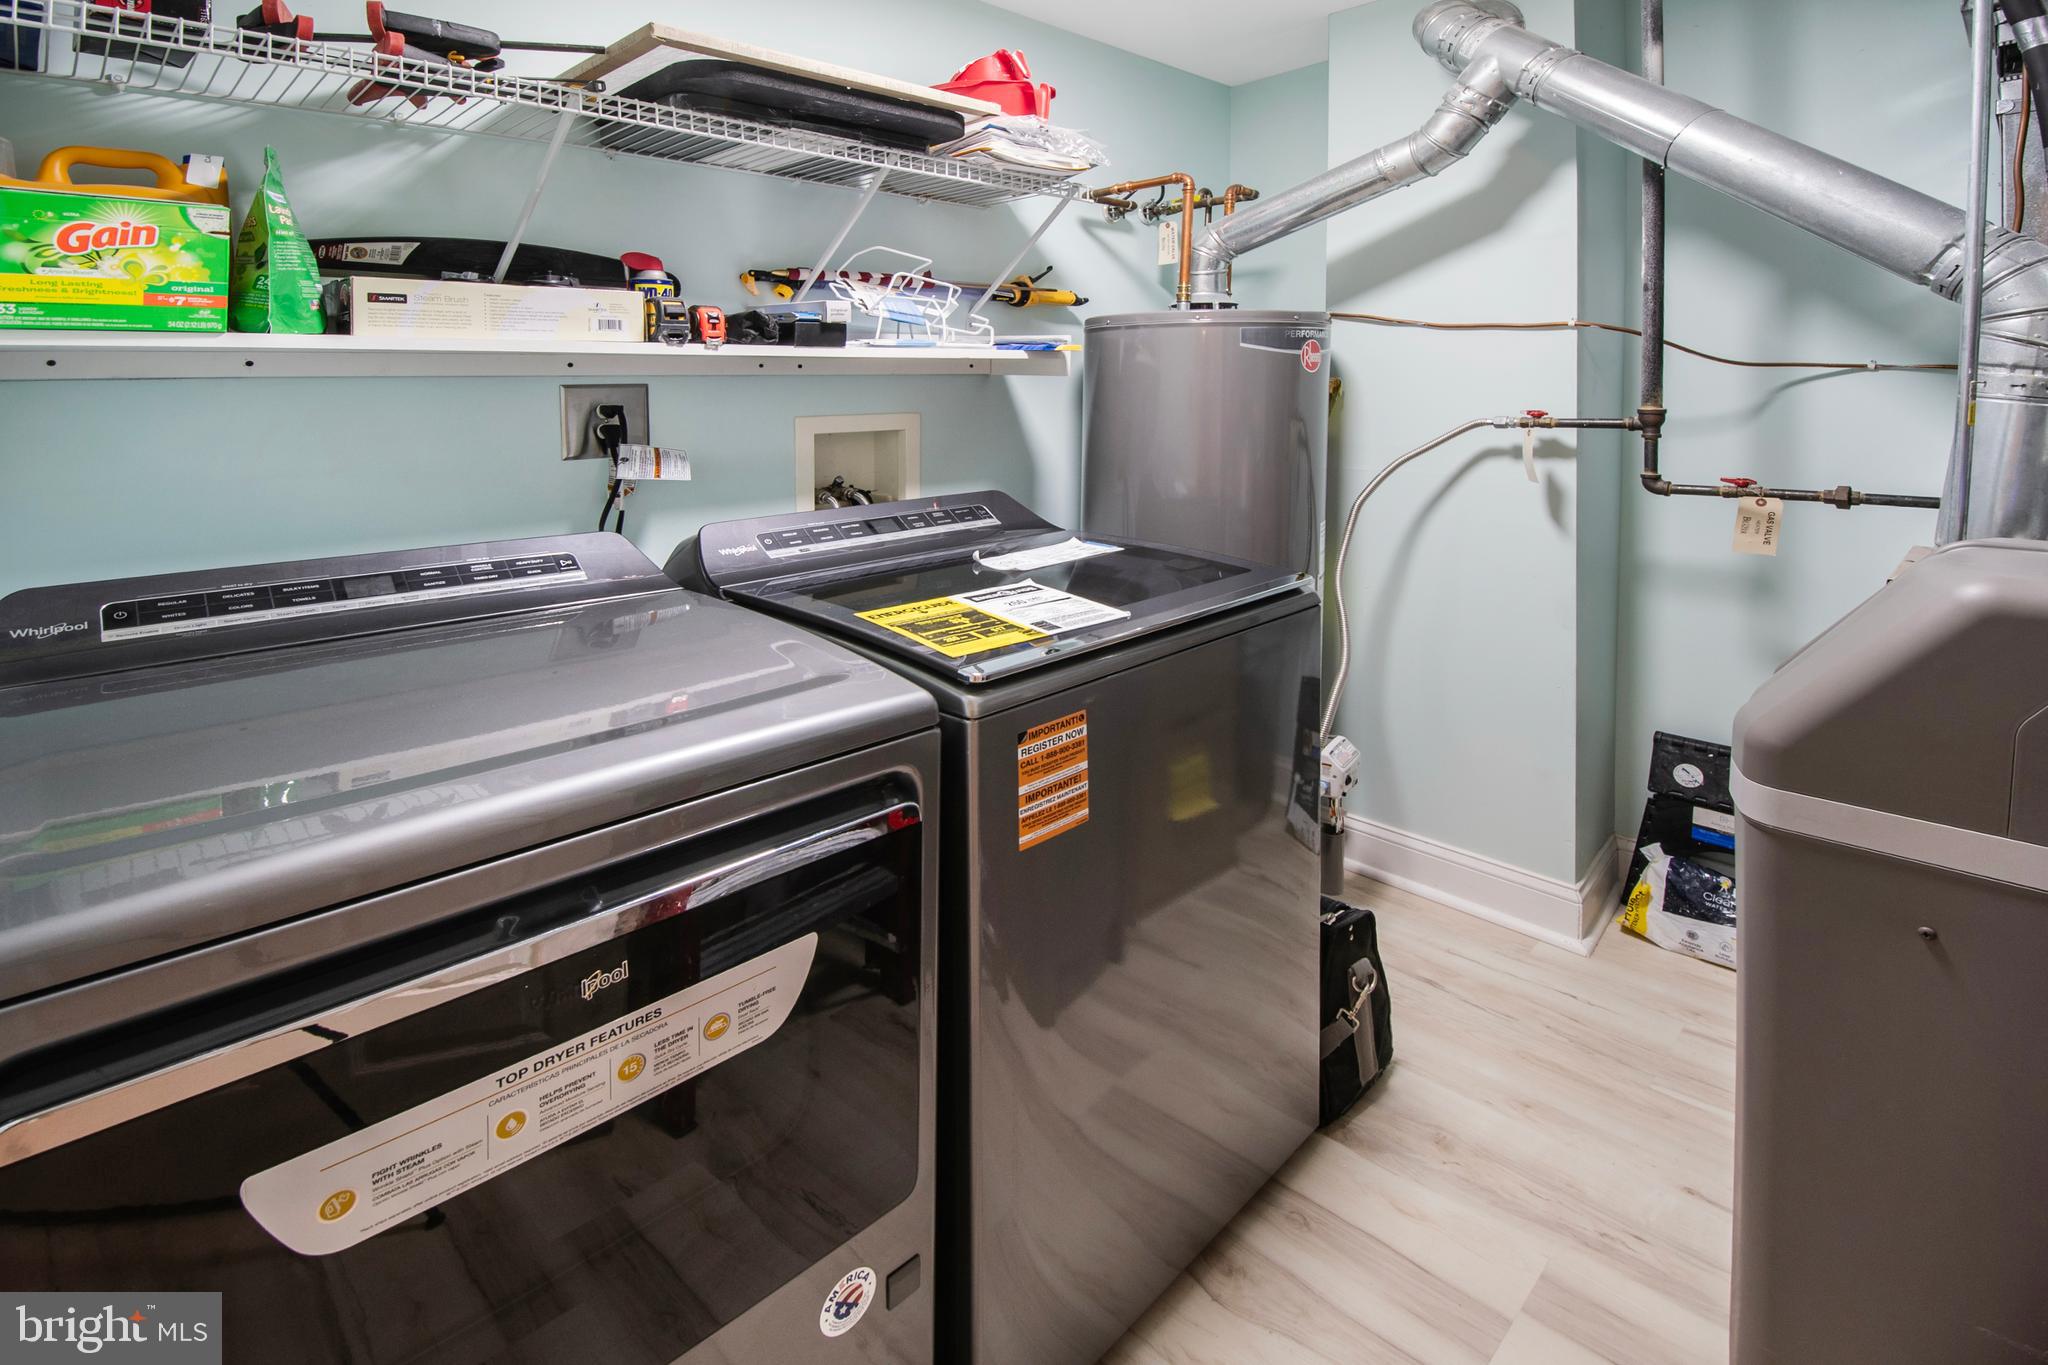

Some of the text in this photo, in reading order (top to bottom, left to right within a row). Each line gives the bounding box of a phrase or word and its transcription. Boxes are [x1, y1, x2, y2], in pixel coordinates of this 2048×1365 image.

[56, 220, 159, 256] Gain
[30, 279, 103, 289] Long Lasting
[72, 288, 137, 296] Brightness!
[171, 285, 214, 293] original
[414, 295, 442, 303] Steam
[445, 296, 469, 304] Brush
[1763, 511, 1776, 545] GAS VALVE
[9, 621, 89, 640] Whirlpool
[1029, 716, 1078, 740] IMPORTANT!
[1021, 727, 1085, 758] REGISTER NOW
[1020, 757, 1039, 769] CALL
[1025, 774, 1082, 804] IMPORTANTE!
[1057, 783, 1087, 800] MAINTENANT
[738, 986, 776, 1008] TUMBLE-FREE
[738, 1000, 760, 1014] DRYING
[496, 1007, 663, 1088] TOP DRYER FEATURES
[561, 1049, 609, 1075] PRINCIPALES
[609, 1046, 620, 1054] DE
[620, 1039, 631, 1049] LA
[631, 1022, 669, 1045] SECADORA
[654, 1036, 671, 1048] LESS
[671, 1029, 686, 1040] TIME
[655, 1034, 689, 1054] THE DRYER
[623, 1061, 638, 1075] 15
[539, 1071, 596, 1102] HELPS PREVENT
[539, 1083, 586, 1108] OVERDRYING
[371, 1142, 443, 1179] FIGHT WRINKLES
[372, 1157, 425, 1186] WITH STEAM
[824, 1270, 871, 1314] AMERICA
